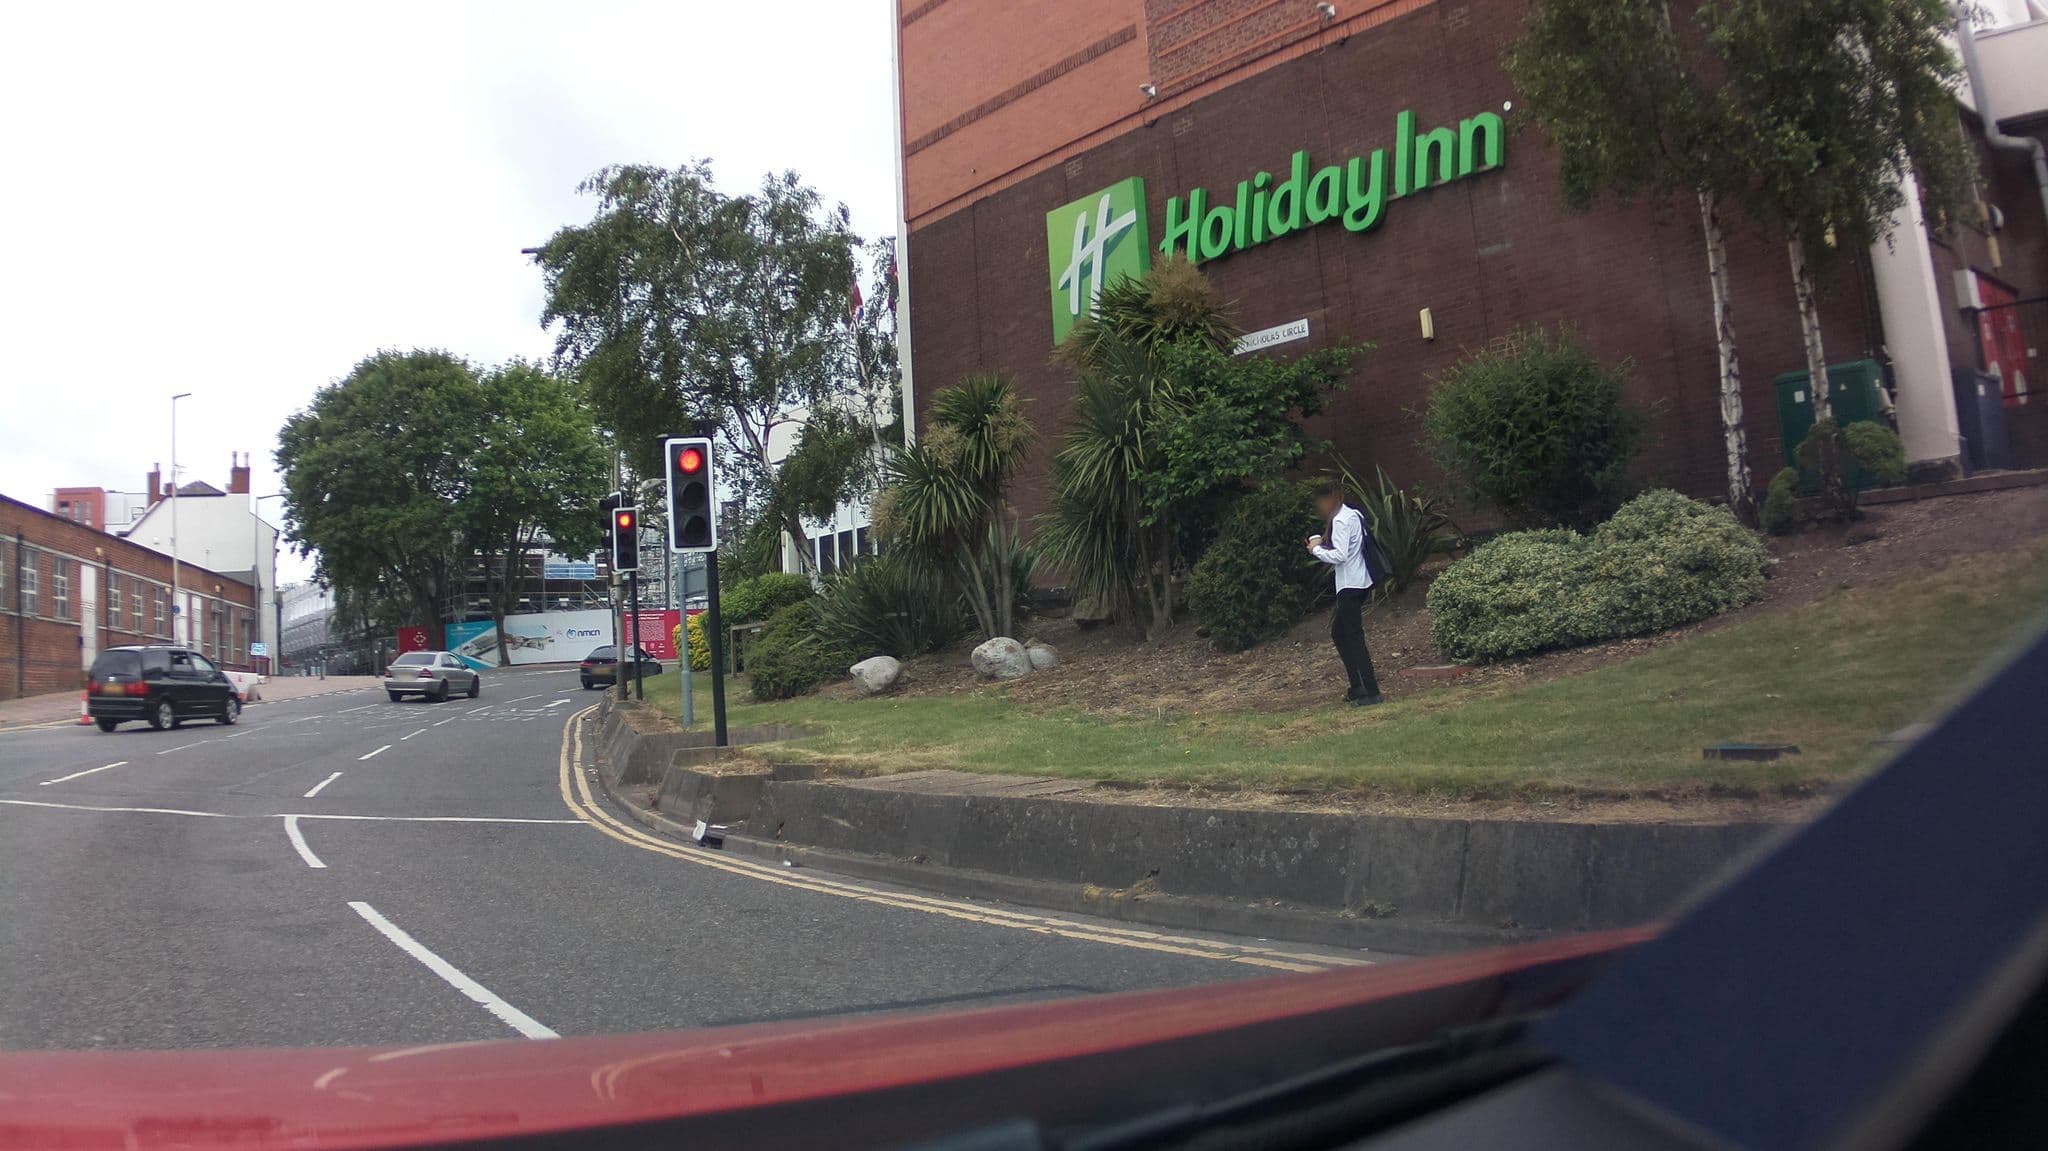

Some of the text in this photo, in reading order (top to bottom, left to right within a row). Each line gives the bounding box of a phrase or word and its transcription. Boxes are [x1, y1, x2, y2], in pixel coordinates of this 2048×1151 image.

[1159, 109, 1504, 265] Holiday Inn
[1282, 323, 1306, 338] CIRCLE
[577, 629, 601, 637] nmcn
